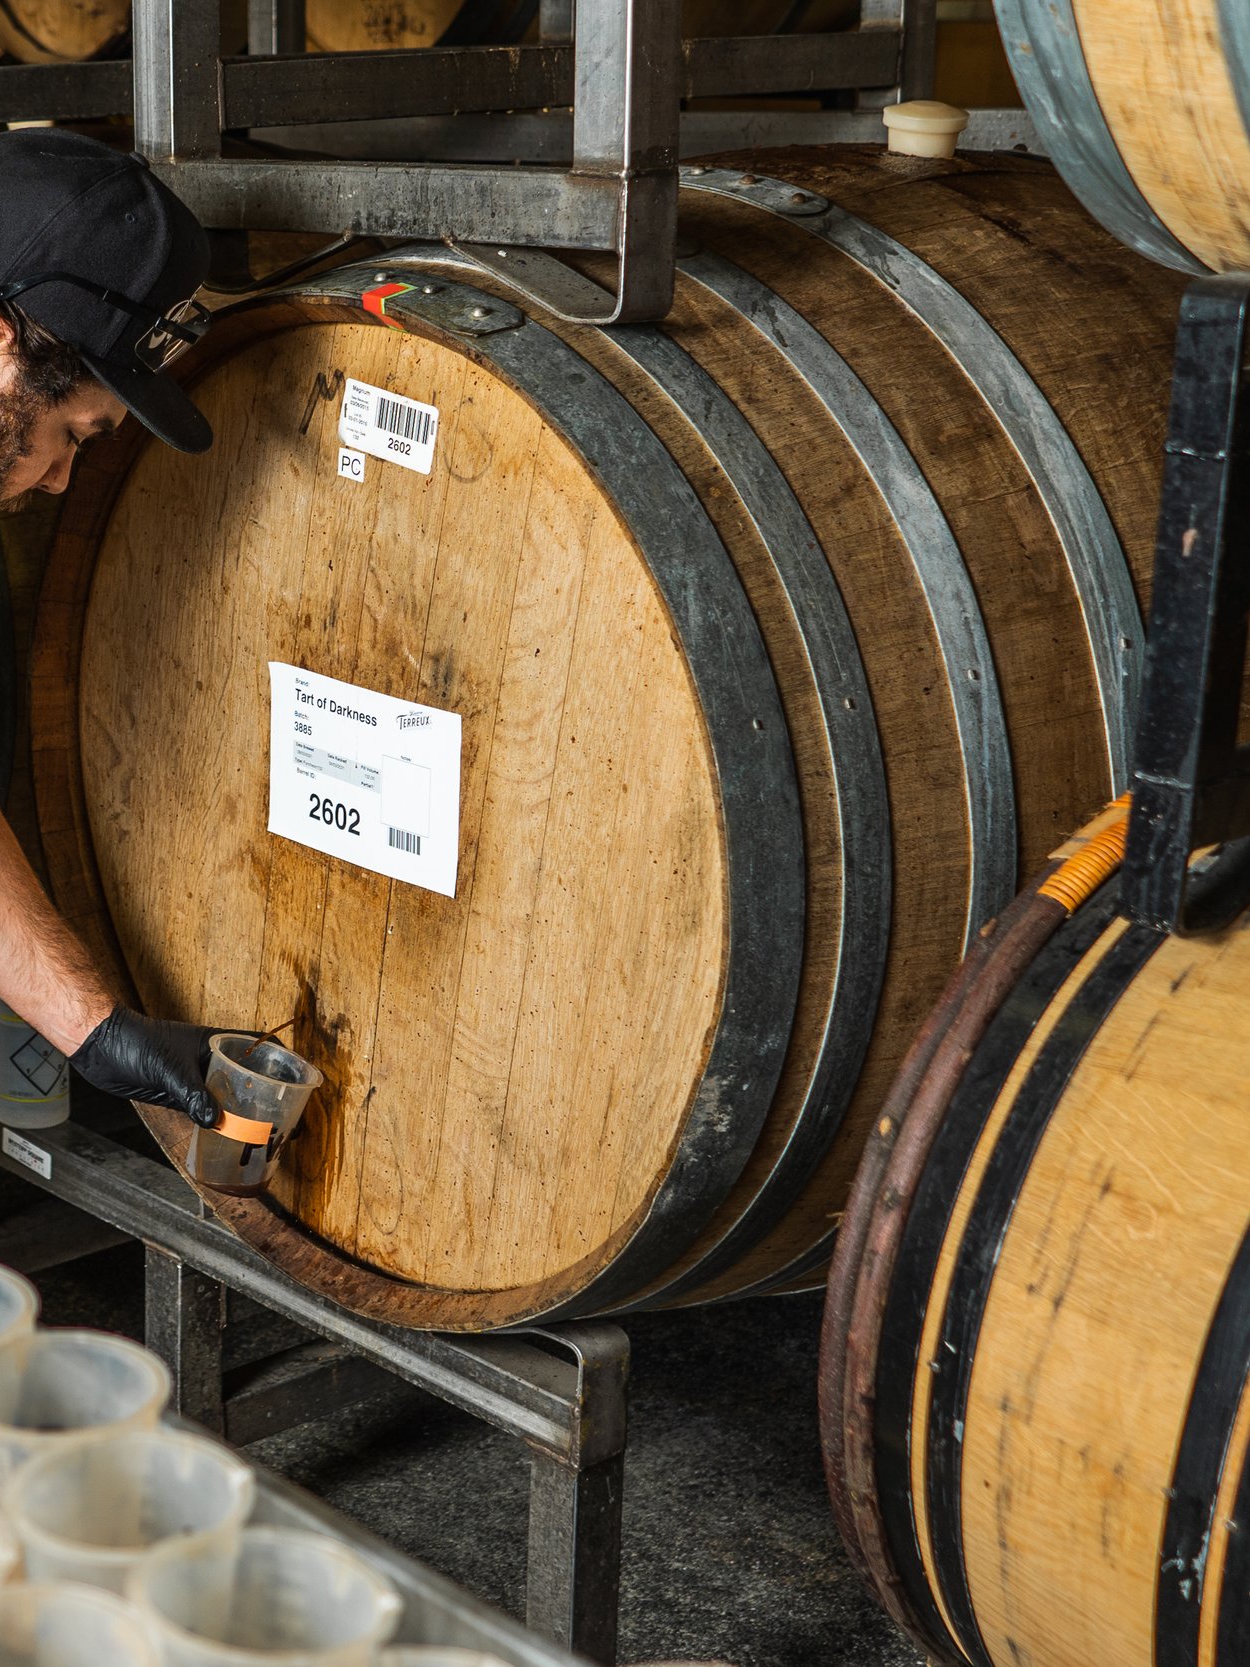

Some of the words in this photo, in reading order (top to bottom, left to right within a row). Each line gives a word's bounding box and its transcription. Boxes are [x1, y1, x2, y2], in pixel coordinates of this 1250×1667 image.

[387, 437, 411, 456] 2602
[341, 455, 361, 476] PC
[295, 688, 314, 706] Tart
[316, 697, 327, 710] of
[329, 700, 378, 727] Darkness
[293, 721, 313, 736] 3885
[396, 713, 431, 731] TERREUX
[308, 793, 361, 837] 2602
